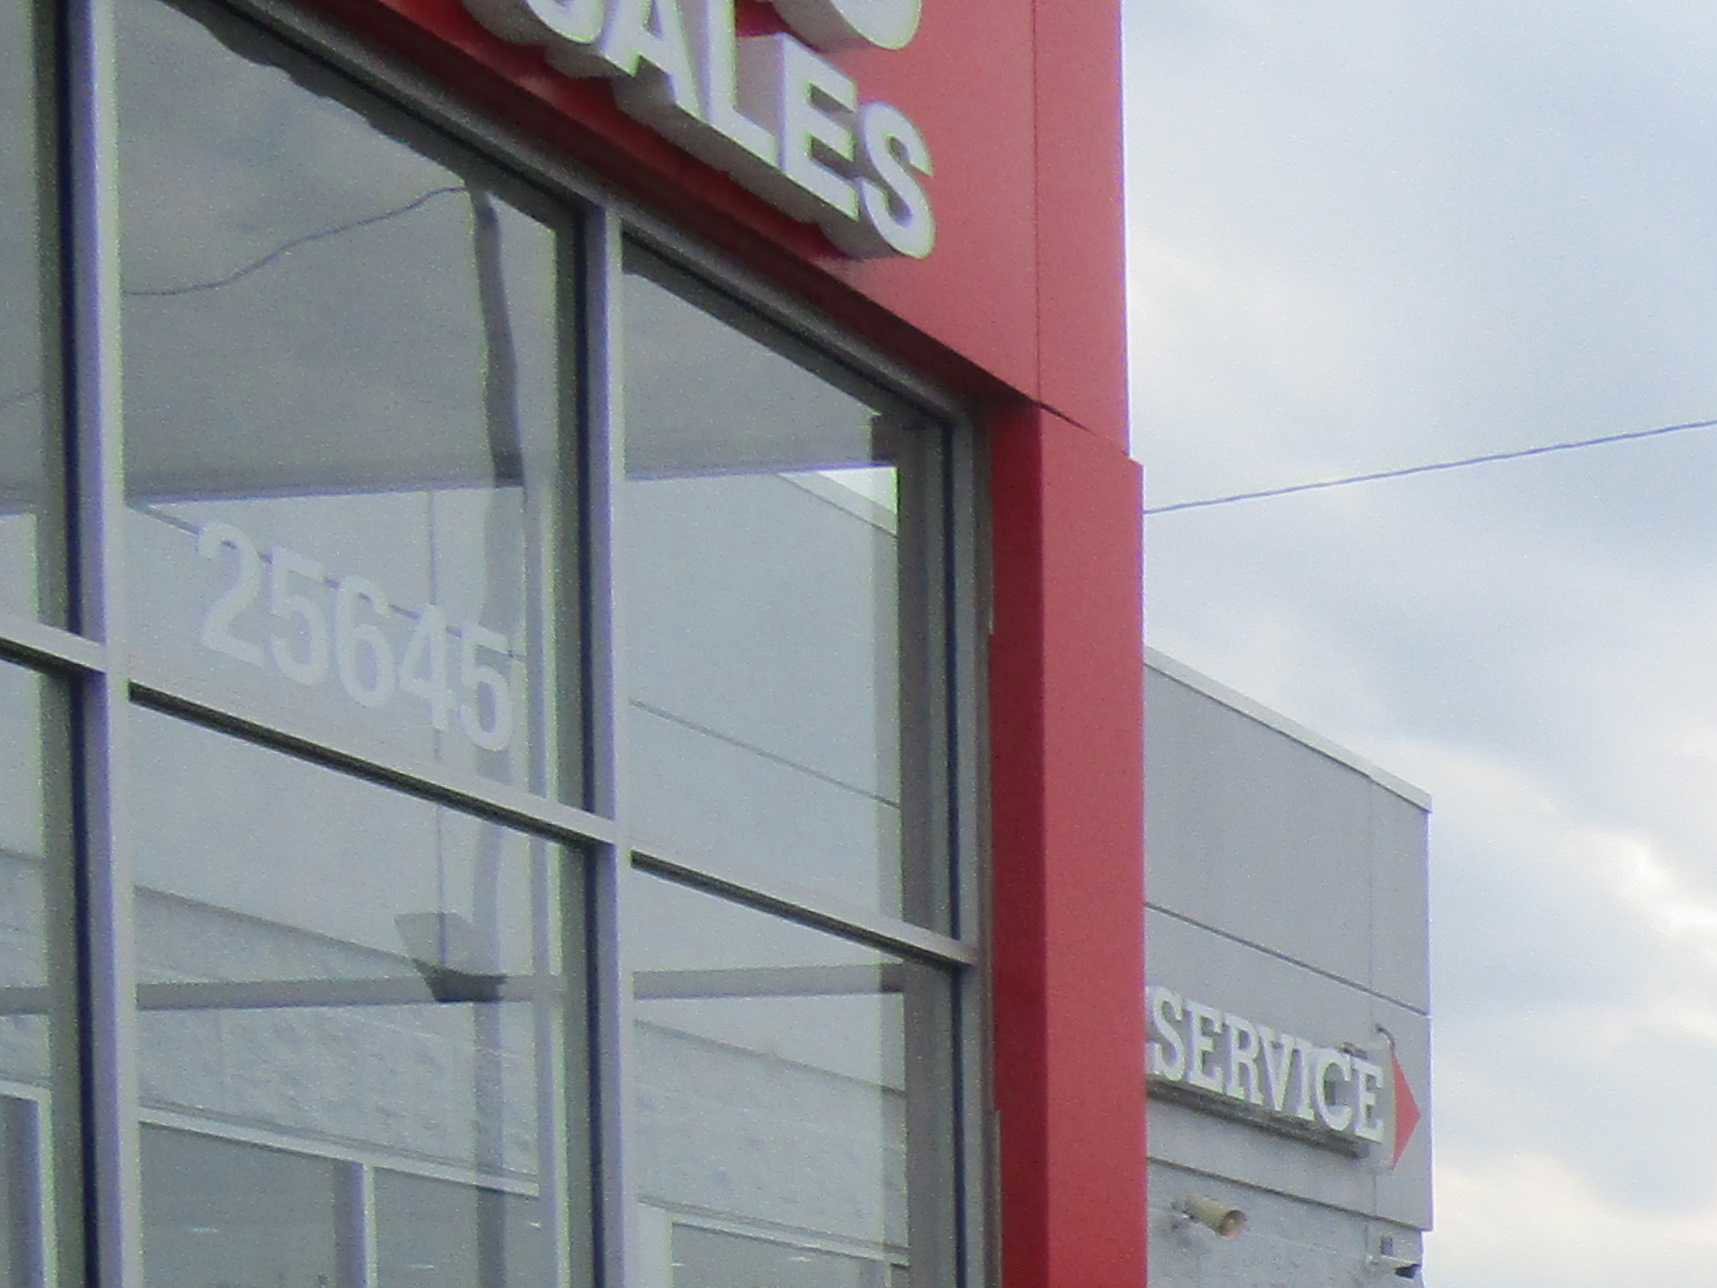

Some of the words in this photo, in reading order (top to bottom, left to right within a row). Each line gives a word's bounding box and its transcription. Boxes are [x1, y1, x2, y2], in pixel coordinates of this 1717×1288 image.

[525, 0, 936, 260] ALES
[200, 523, 513, 753] 25645
[1147, 986, 1385, 1144] SERVICE
